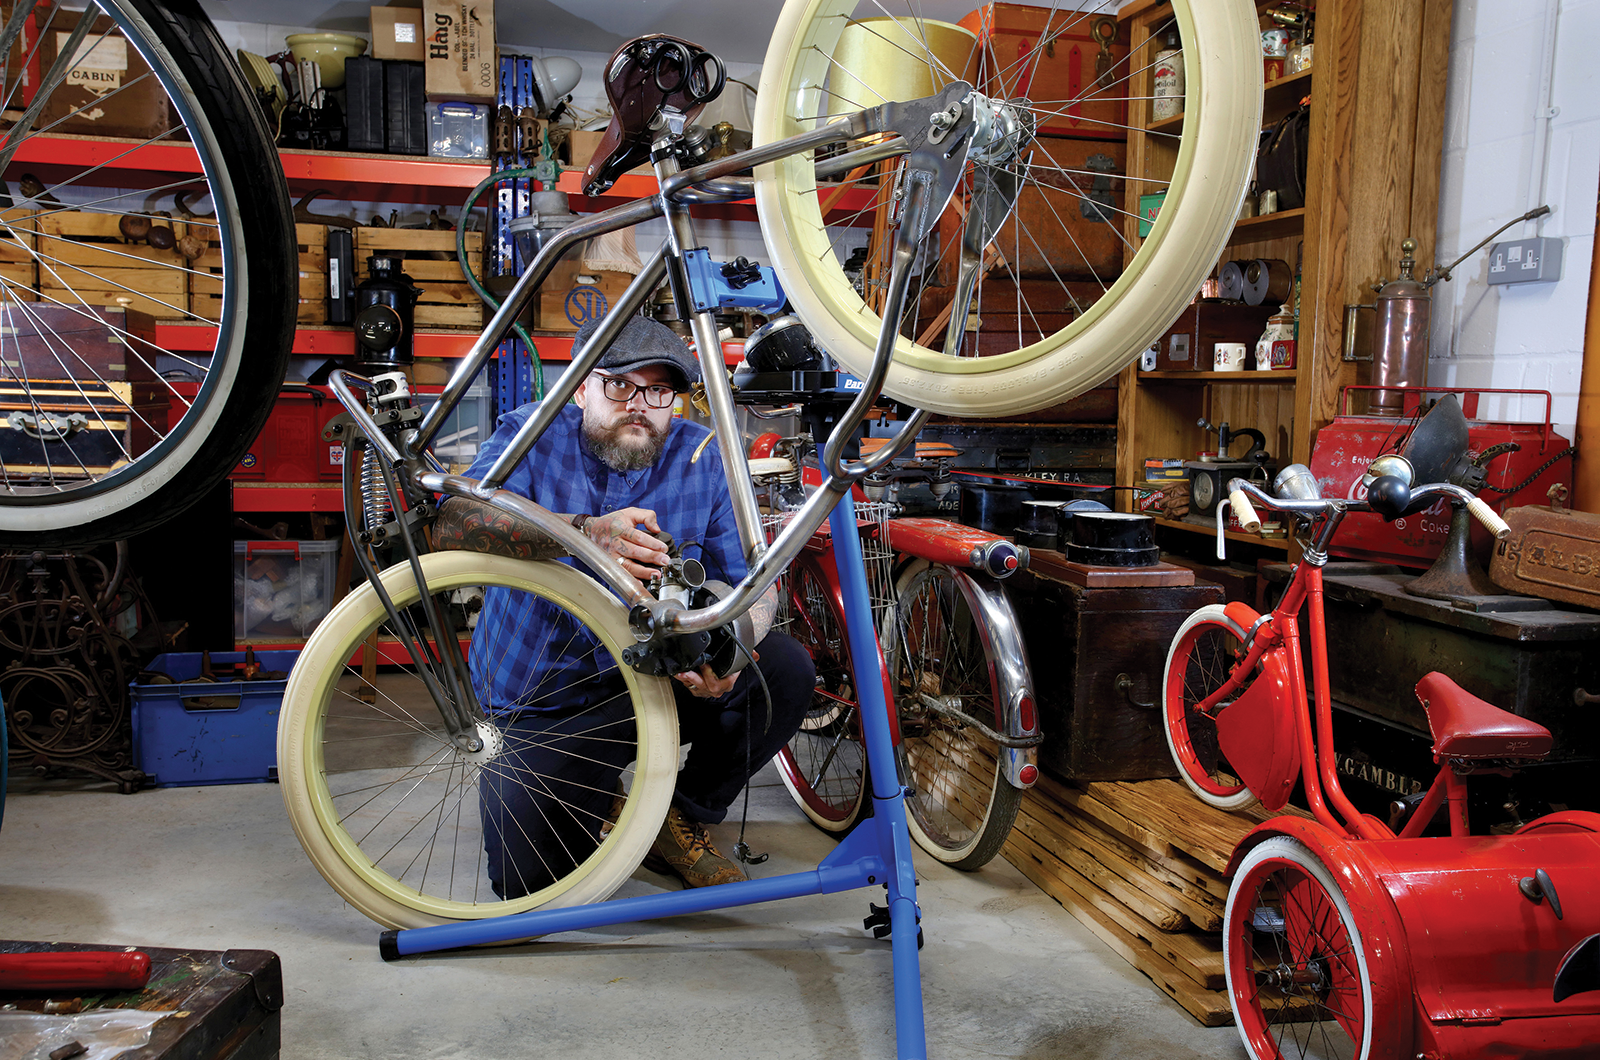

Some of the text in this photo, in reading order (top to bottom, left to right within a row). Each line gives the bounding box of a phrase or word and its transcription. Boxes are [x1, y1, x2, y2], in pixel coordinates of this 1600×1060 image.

[430, 13, 453, 60] Haig
[71, 70, 115, 82] CABIN
[844, 379, 865, 390] Par
[1420, 519, 1451, 534] Coke
